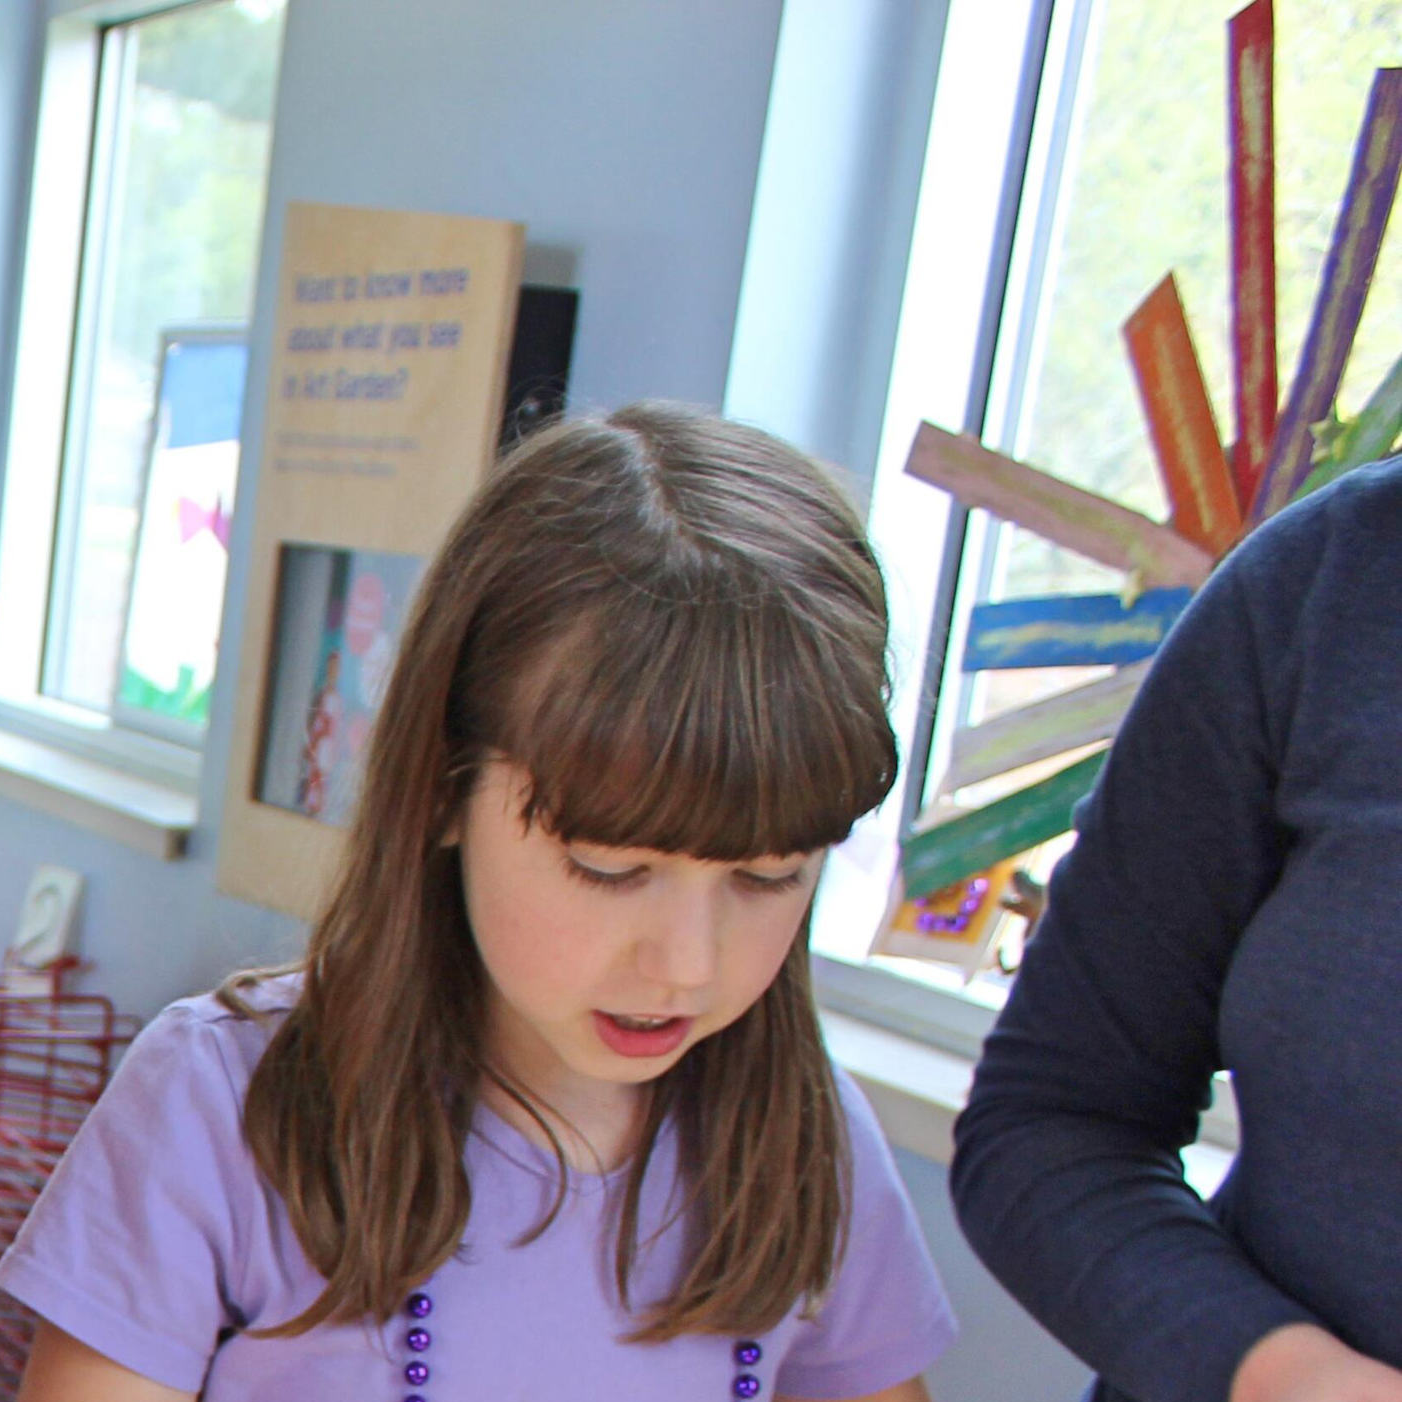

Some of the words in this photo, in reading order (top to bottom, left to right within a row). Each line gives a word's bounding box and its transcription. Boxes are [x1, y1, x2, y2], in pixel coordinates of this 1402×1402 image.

[295, 276, 337, 304] Want
[343, 276, 359, 302] to
[366, 272, 412, 300] know
[419, 269, 470, 296] more
[288, 322, 337, 352] about
[341, 320, 383, 350] what
[386, 322, 423, 356] you
[428, 321, 463, 348] see
[334, 366, 410, 400] Garden?
